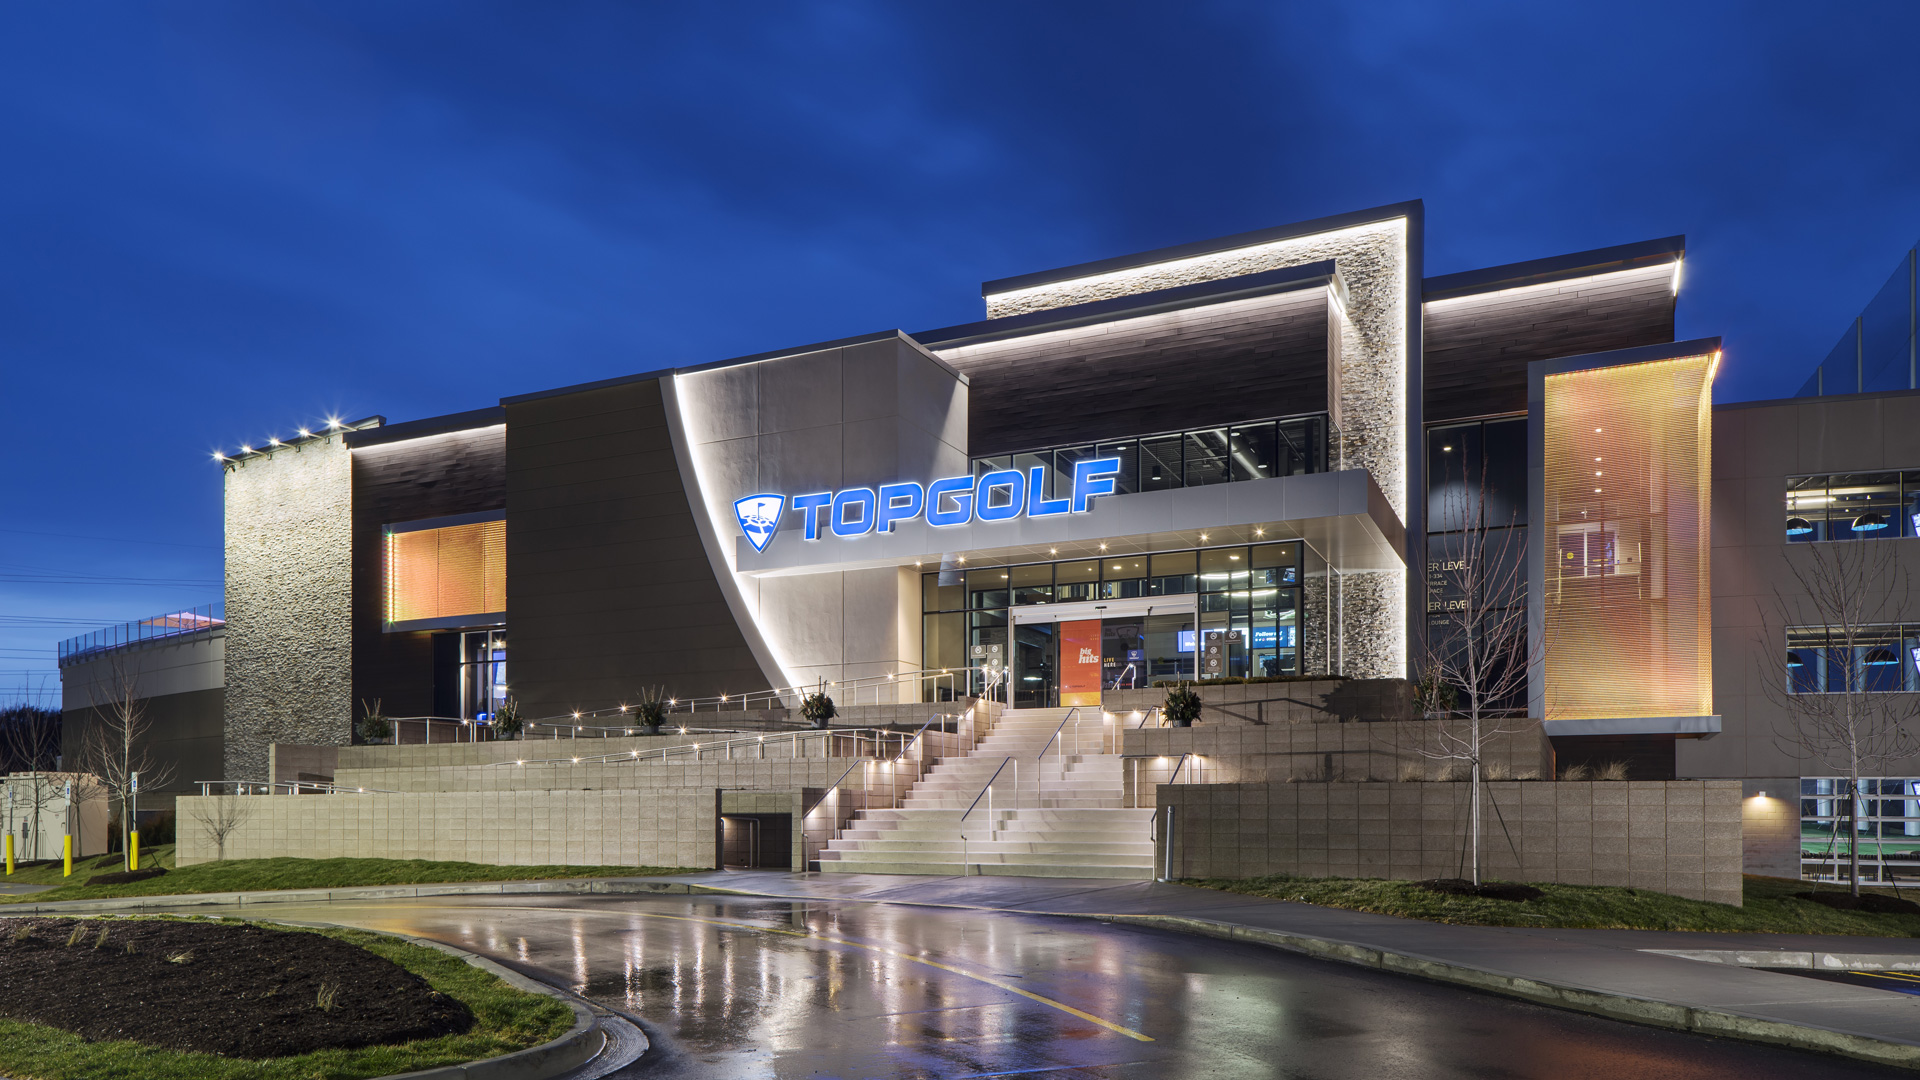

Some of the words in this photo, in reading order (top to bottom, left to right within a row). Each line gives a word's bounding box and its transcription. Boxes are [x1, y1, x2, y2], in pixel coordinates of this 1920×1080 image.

[791, 457, 1121, 541] TOPGOLF
[1080, 647, 1092, 656] big
[1078, 654, 1099, 664] hits
